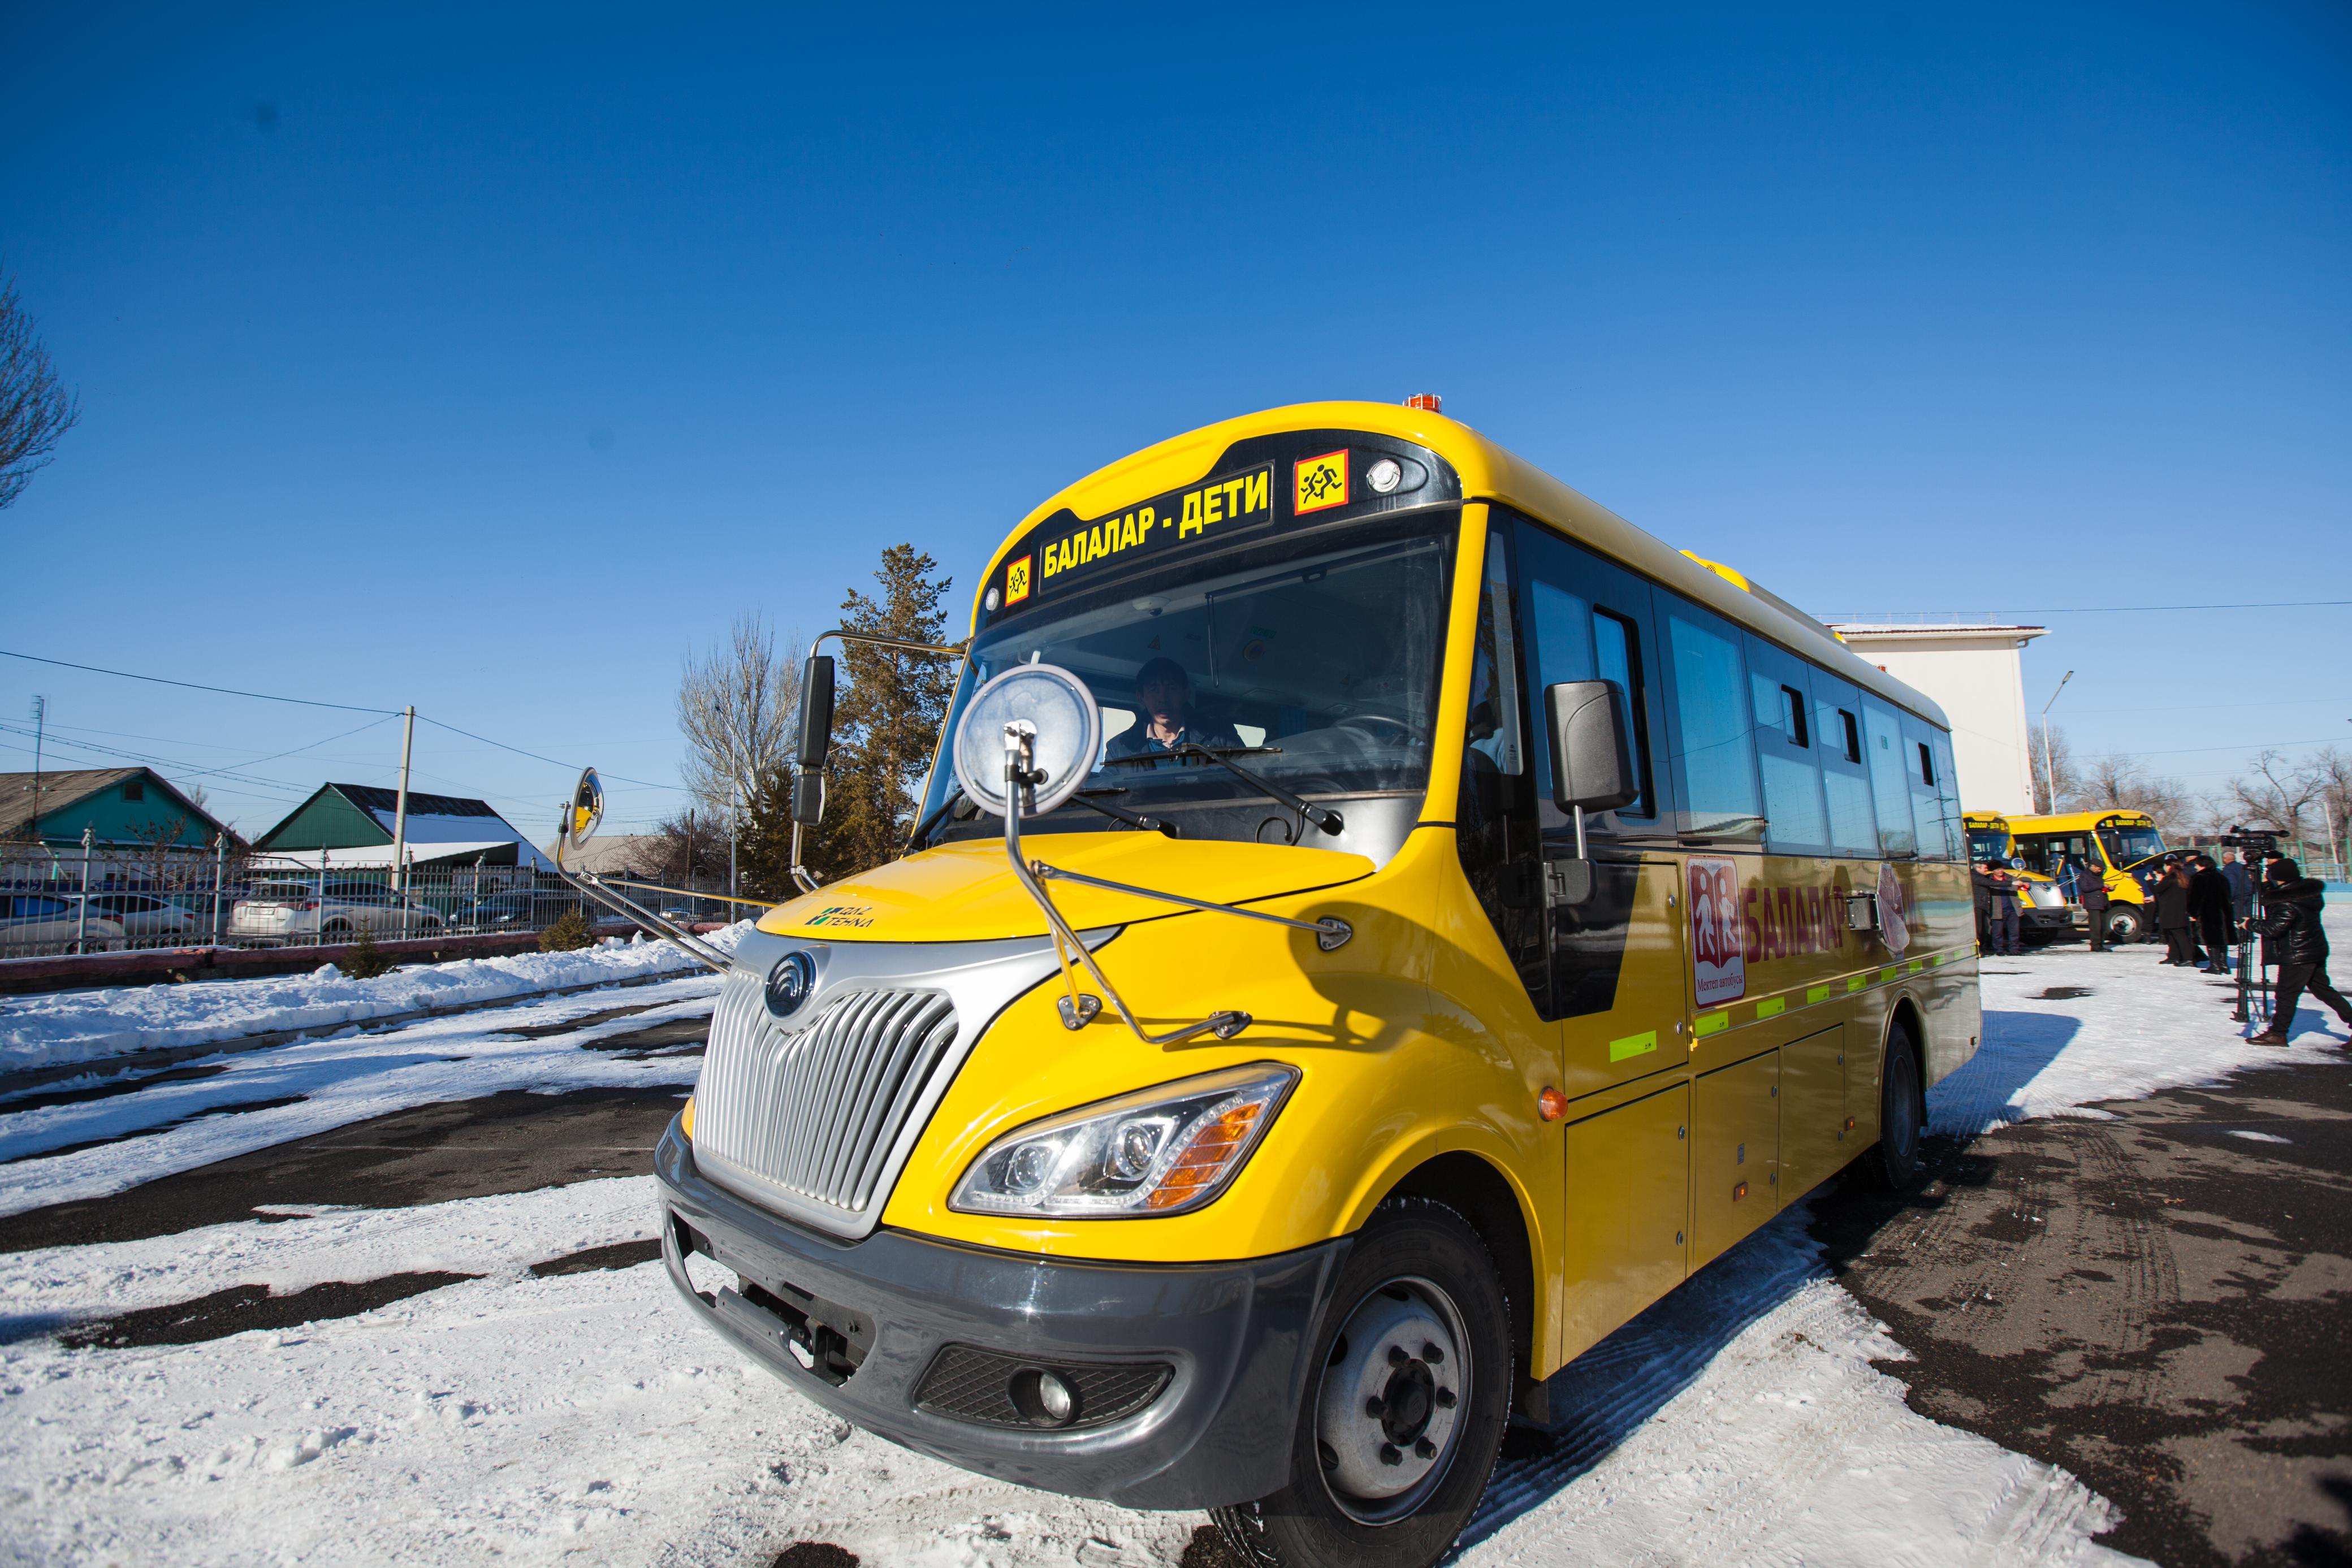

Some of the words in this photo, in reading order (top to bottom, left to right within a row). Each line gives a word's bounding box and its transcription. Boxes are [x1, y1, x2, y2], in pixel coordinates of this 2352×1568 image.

[1044, 506, 1155, 578] БАЛАЛАР
[1179, 471, 1268, 539] ДЕТИ
[839, 907, 872, 916] QAZ
[825, 917, 875, 928] TEHNA
[1741, 886, 1845, 964] БАЛАЛАР
[1697, 978, 1719, 993] Мектеп
[1719, 972, 1743, 989] автобусы
